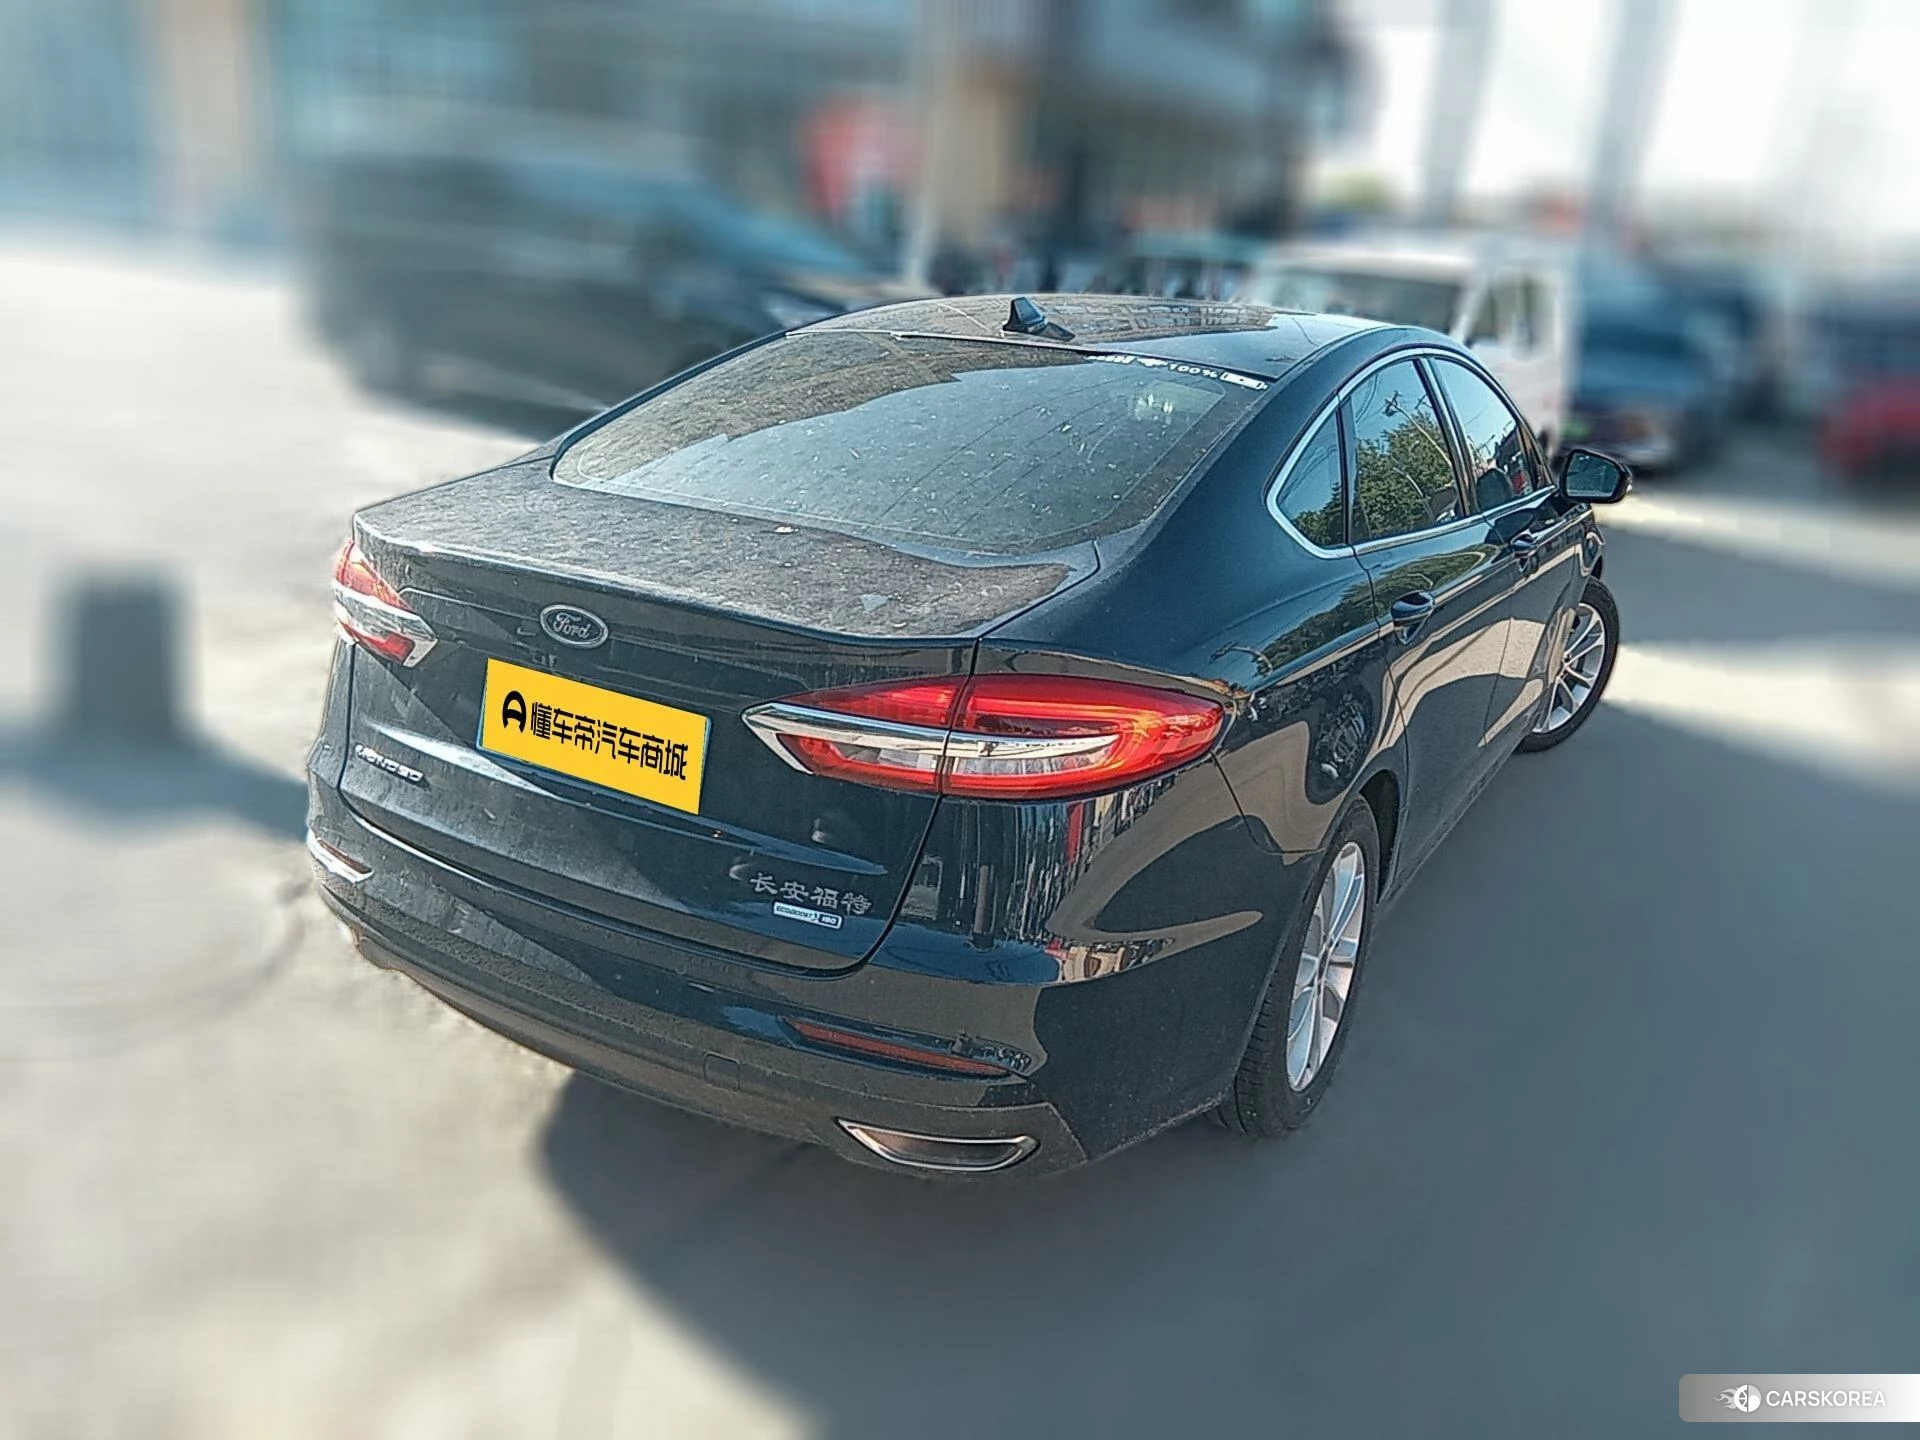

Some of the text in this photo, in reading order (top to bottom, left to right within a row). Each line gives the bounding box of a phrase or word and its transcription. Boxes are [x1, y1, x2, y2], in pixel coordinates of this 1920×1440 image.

[1168, 363, 1218, 378] 100%
[553, 612, 592, 638] Ford
[750, 872, 872, 915] 长安福特
